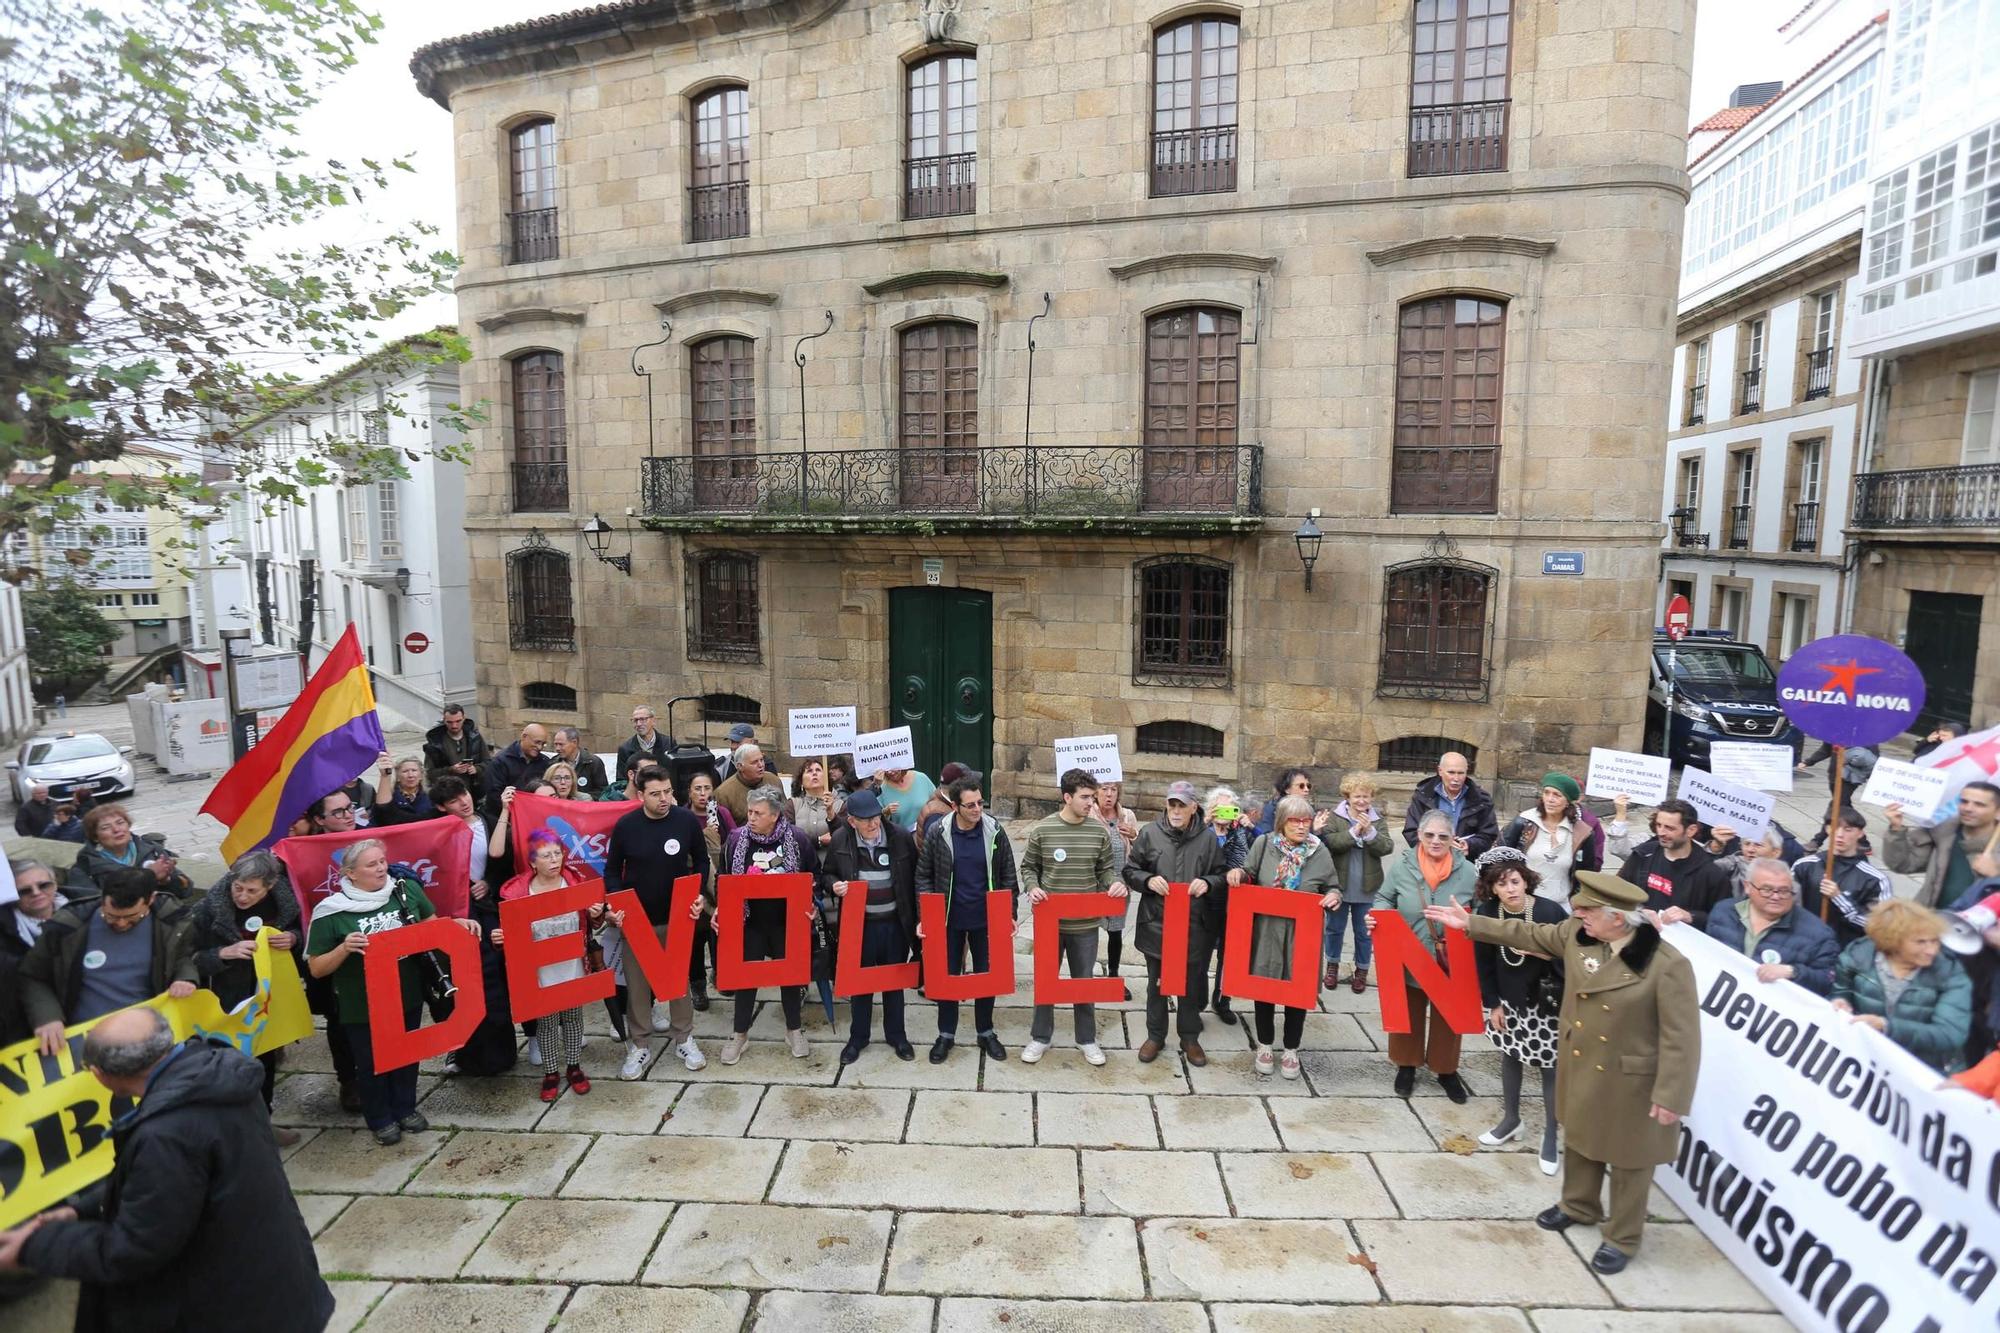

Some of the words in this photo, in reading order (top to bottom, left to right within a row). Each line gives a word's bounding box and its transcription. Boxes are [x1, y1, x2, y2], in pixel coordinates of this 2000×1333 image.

[928, 573, 939, 582] 25
[1781, 687, 1847, 705] GALIZA
[1856, 694, 1911, 712] NOVA
[858, 737, 909, 752] FRANQUISMO
[1074, 742, 1117, 751] DEVOLVAN
[861, 753, 889, 764] NUNCA
[889, 749, 909, 759] MAIS
[1076, 756, 1098, 764] TODO
[1690, 780, 1767, 813] FRANQUISMO
[1687, 794, 1726, 814] NUNCA
[1729, 810, 1760, 826] MAIS
[1700, 969, 1910, 1146] Devolución
[1919, 1109, 1973, 1193] da
[1743, 1094, 1801, 1153] ao
[1791, 1131, 1923, 1243] pobo
[1917, 1220, 1998, 1305] da
